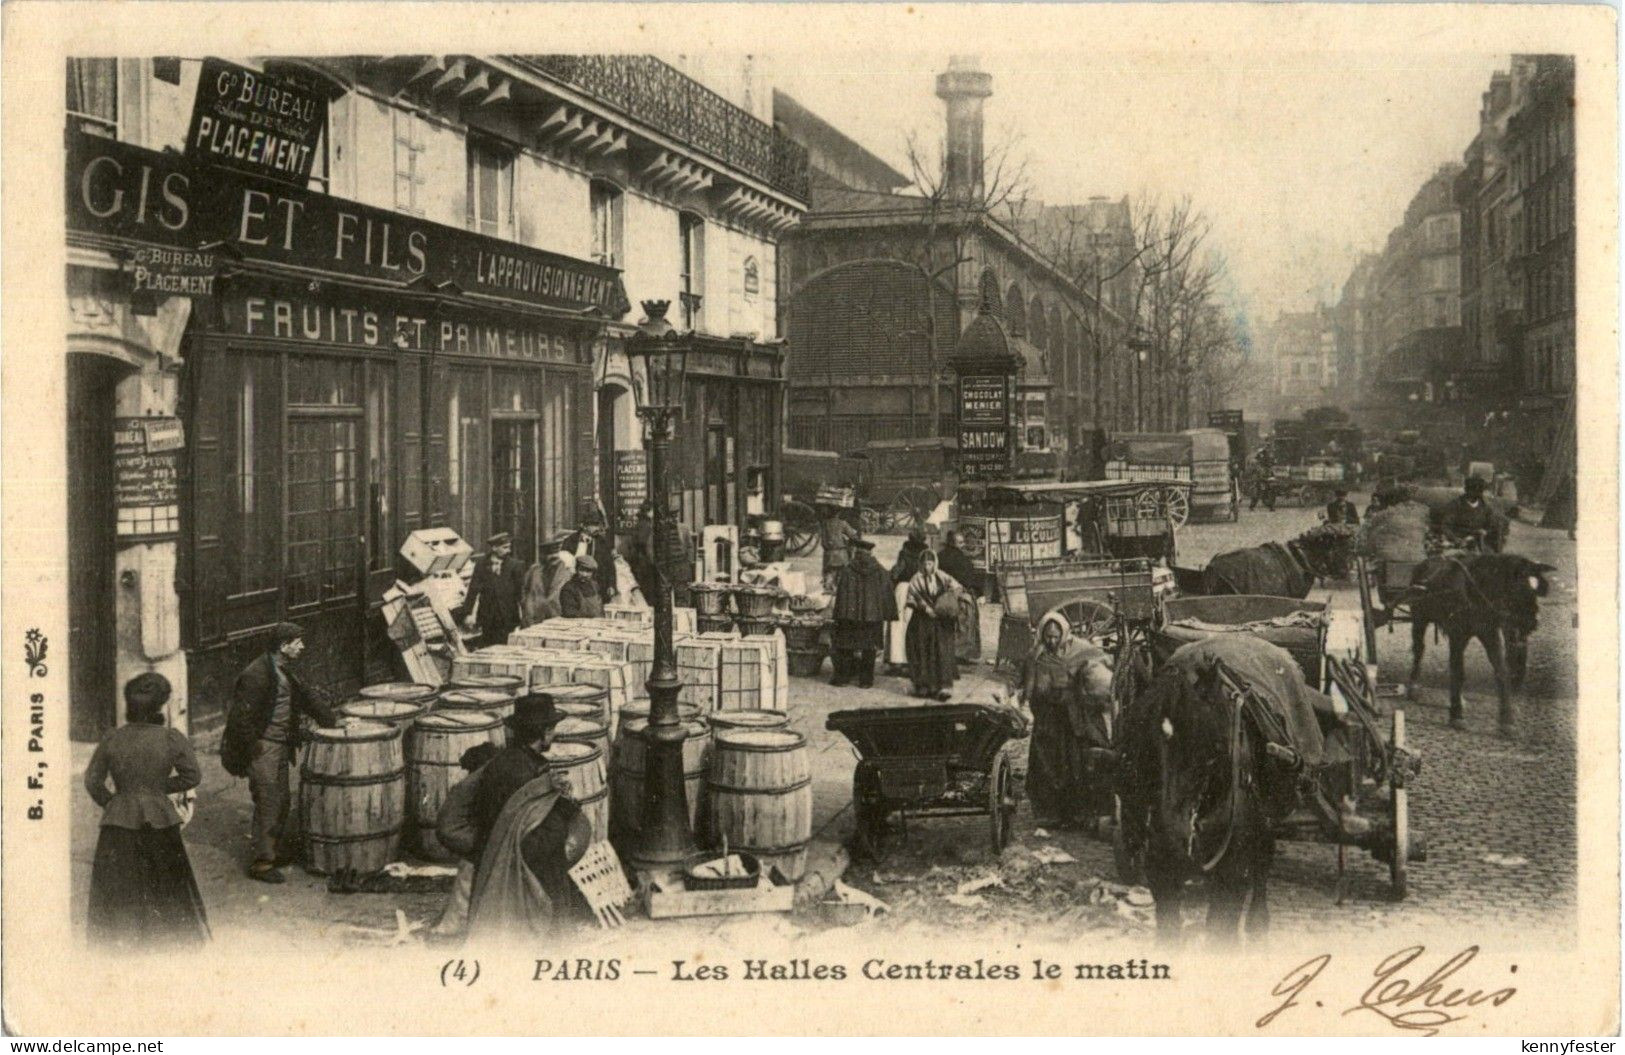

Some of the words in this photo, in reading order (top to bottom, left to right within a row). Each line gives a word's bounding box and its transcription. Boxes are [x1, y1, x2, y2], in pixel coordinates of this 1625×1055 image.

[237, 71, 317, 123] BUREAU
[196, 115, 311, 175] PLACEMENT
[82, 156, 190, 231] GIS
[238, 189, 305, 251] ET
[333, 211, 428, 275] FILS
[150, 248, 214, 268] BUREAU
[133, 265, 216, 295] PLACEMENT
[245, 299, 379, 346] FRUITS
[440, 321, 566, 360] PRIMEURS
[963, 390, 1002, 400] CHOCOLAT
[965, 401, 1001, 410] MENIER
[962, 431, 1005, 449] SANDOW
